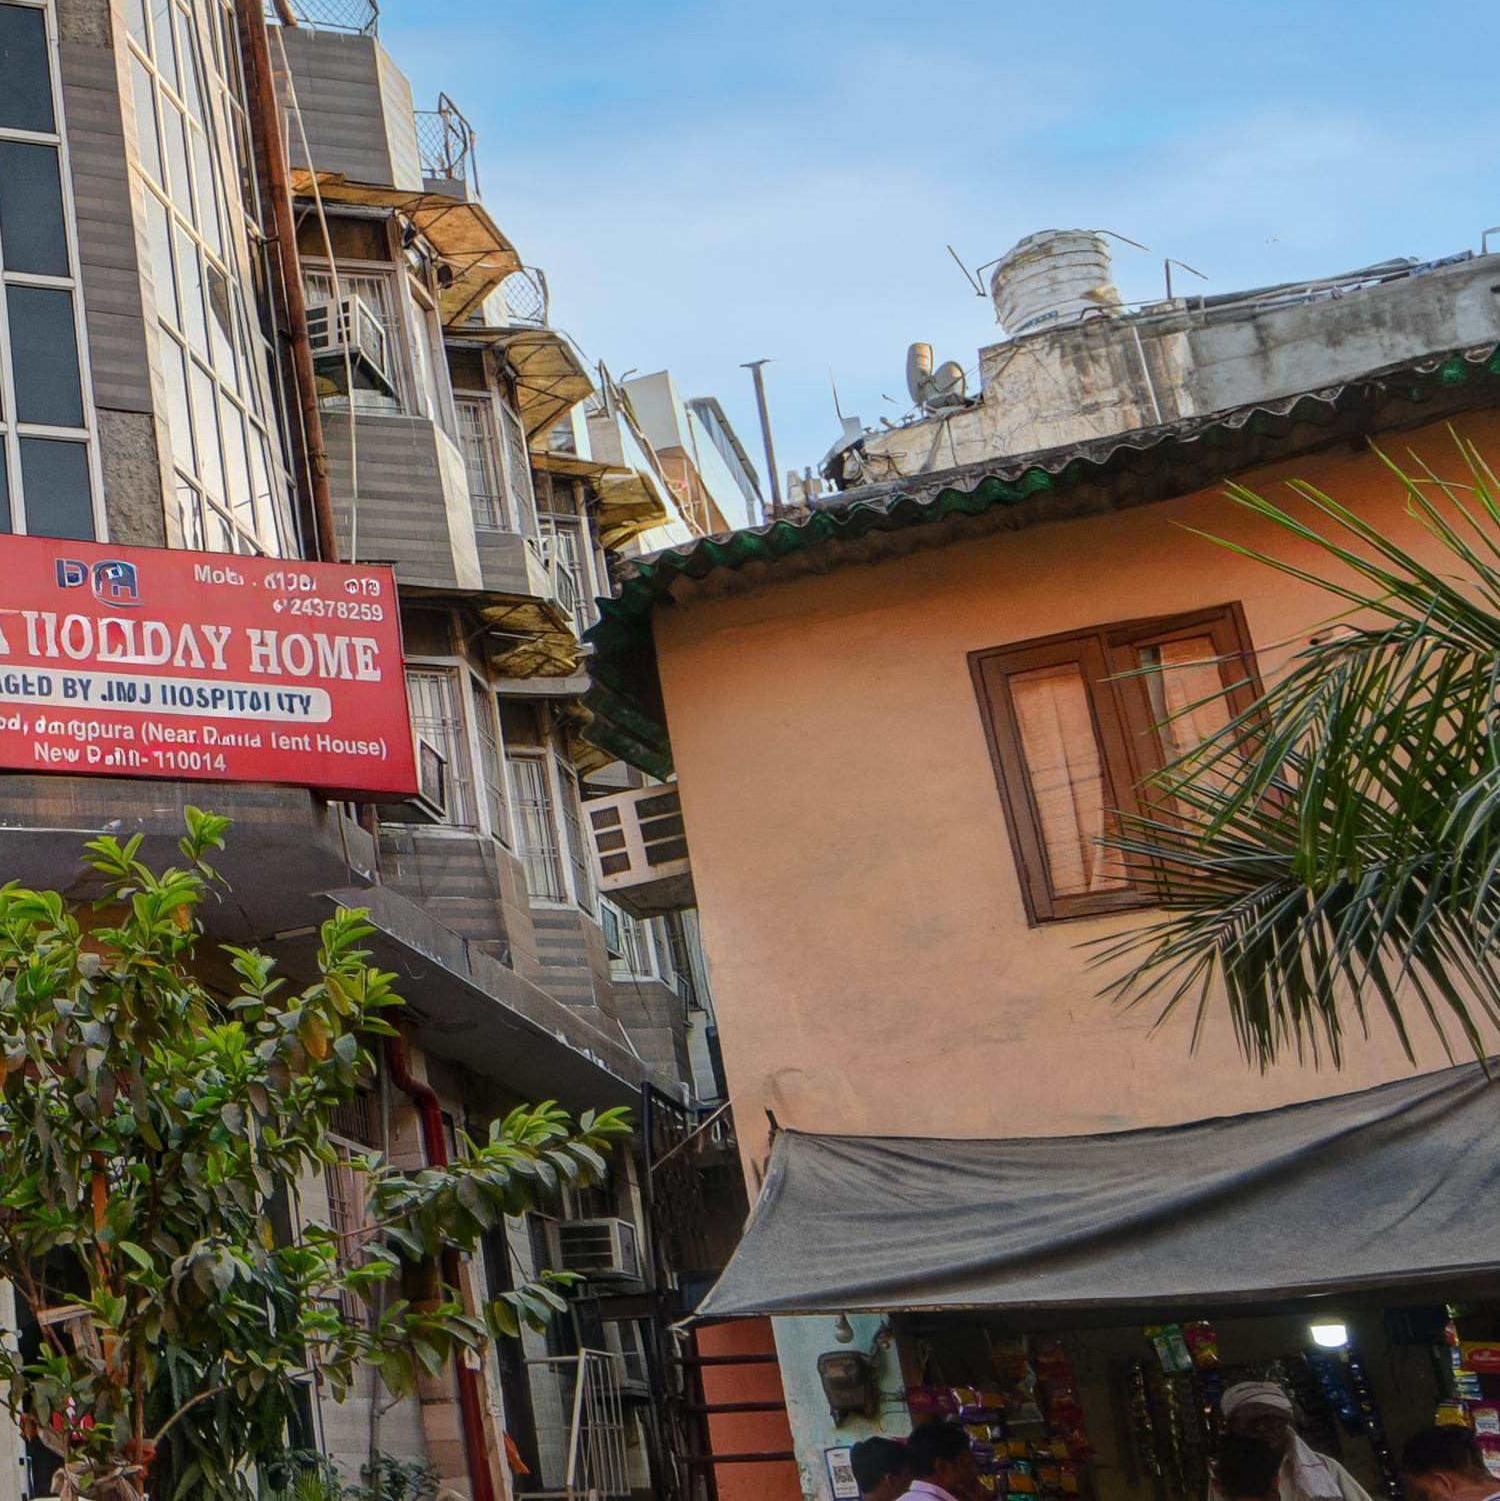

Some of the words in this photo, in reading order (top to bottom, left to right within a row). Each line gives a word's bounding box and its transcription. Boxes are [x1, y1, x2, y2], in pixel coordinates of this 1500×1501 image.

[246, 628, 383, 682] HOME
[62, 677, 93, 702] BY
[34, 741, 80, 763] New
[316, 737, 388, 761] House)
